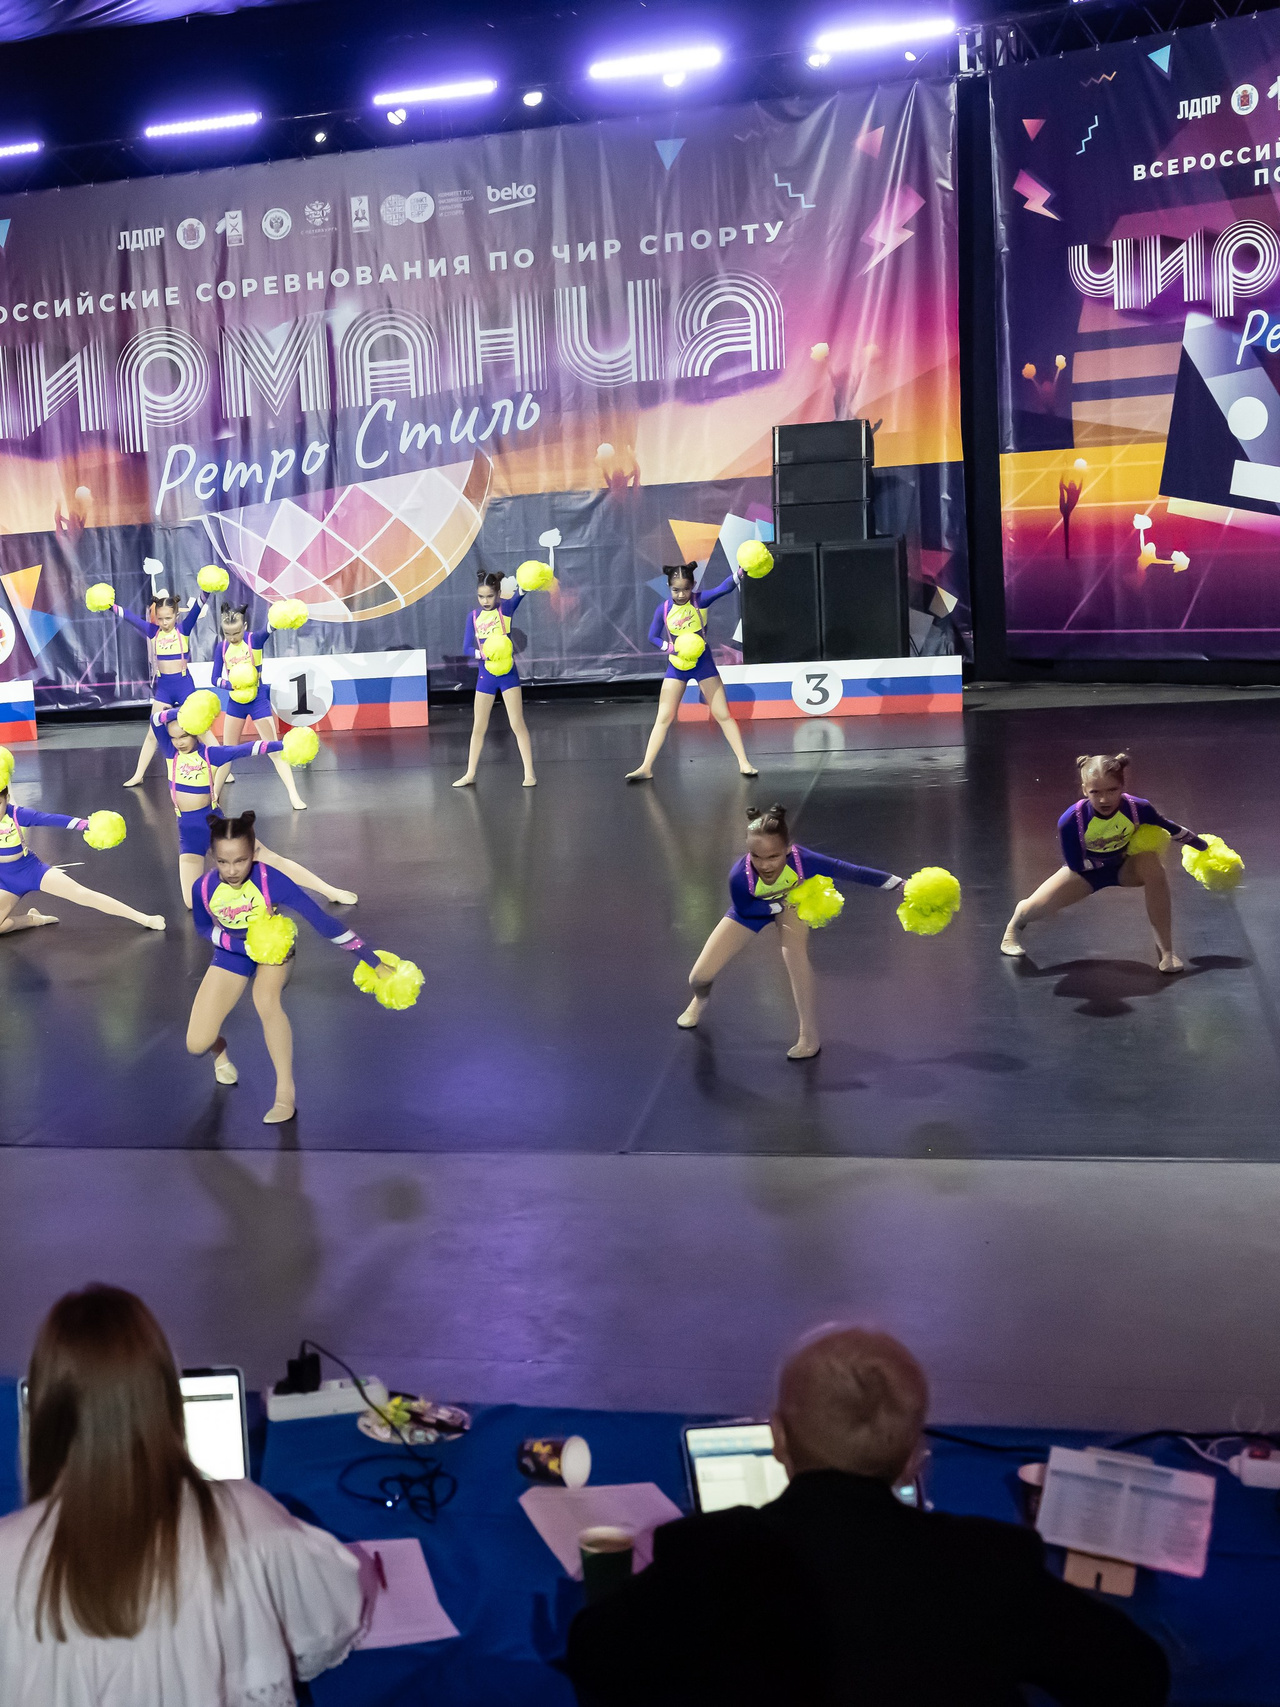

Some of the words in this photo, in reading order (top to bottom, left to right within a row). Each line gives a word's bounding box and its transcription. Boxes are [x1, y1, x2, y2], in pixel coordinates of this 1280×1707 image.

[1176, 95, 1221, 120] ЛДПР
[1133, 138, 1280, 181] ВСЕРОССИ
[486, 182, 536, 202] beko
[117, 228, 165, 251] ЛДПР
[196, 256, 472, 302] СОРЕВНОВАНИЯ
[489, 249, 535, 272] ПО
[552, 239, 622, 265] ЧИР
[640, 220, 784, 255] СПОРТУ
[154, 441, 330, 516] Ретро
[355, 392, 541, 470] Стиль
[289, 673, 315, 715] 1
[805, 673, 830, 706] 3
